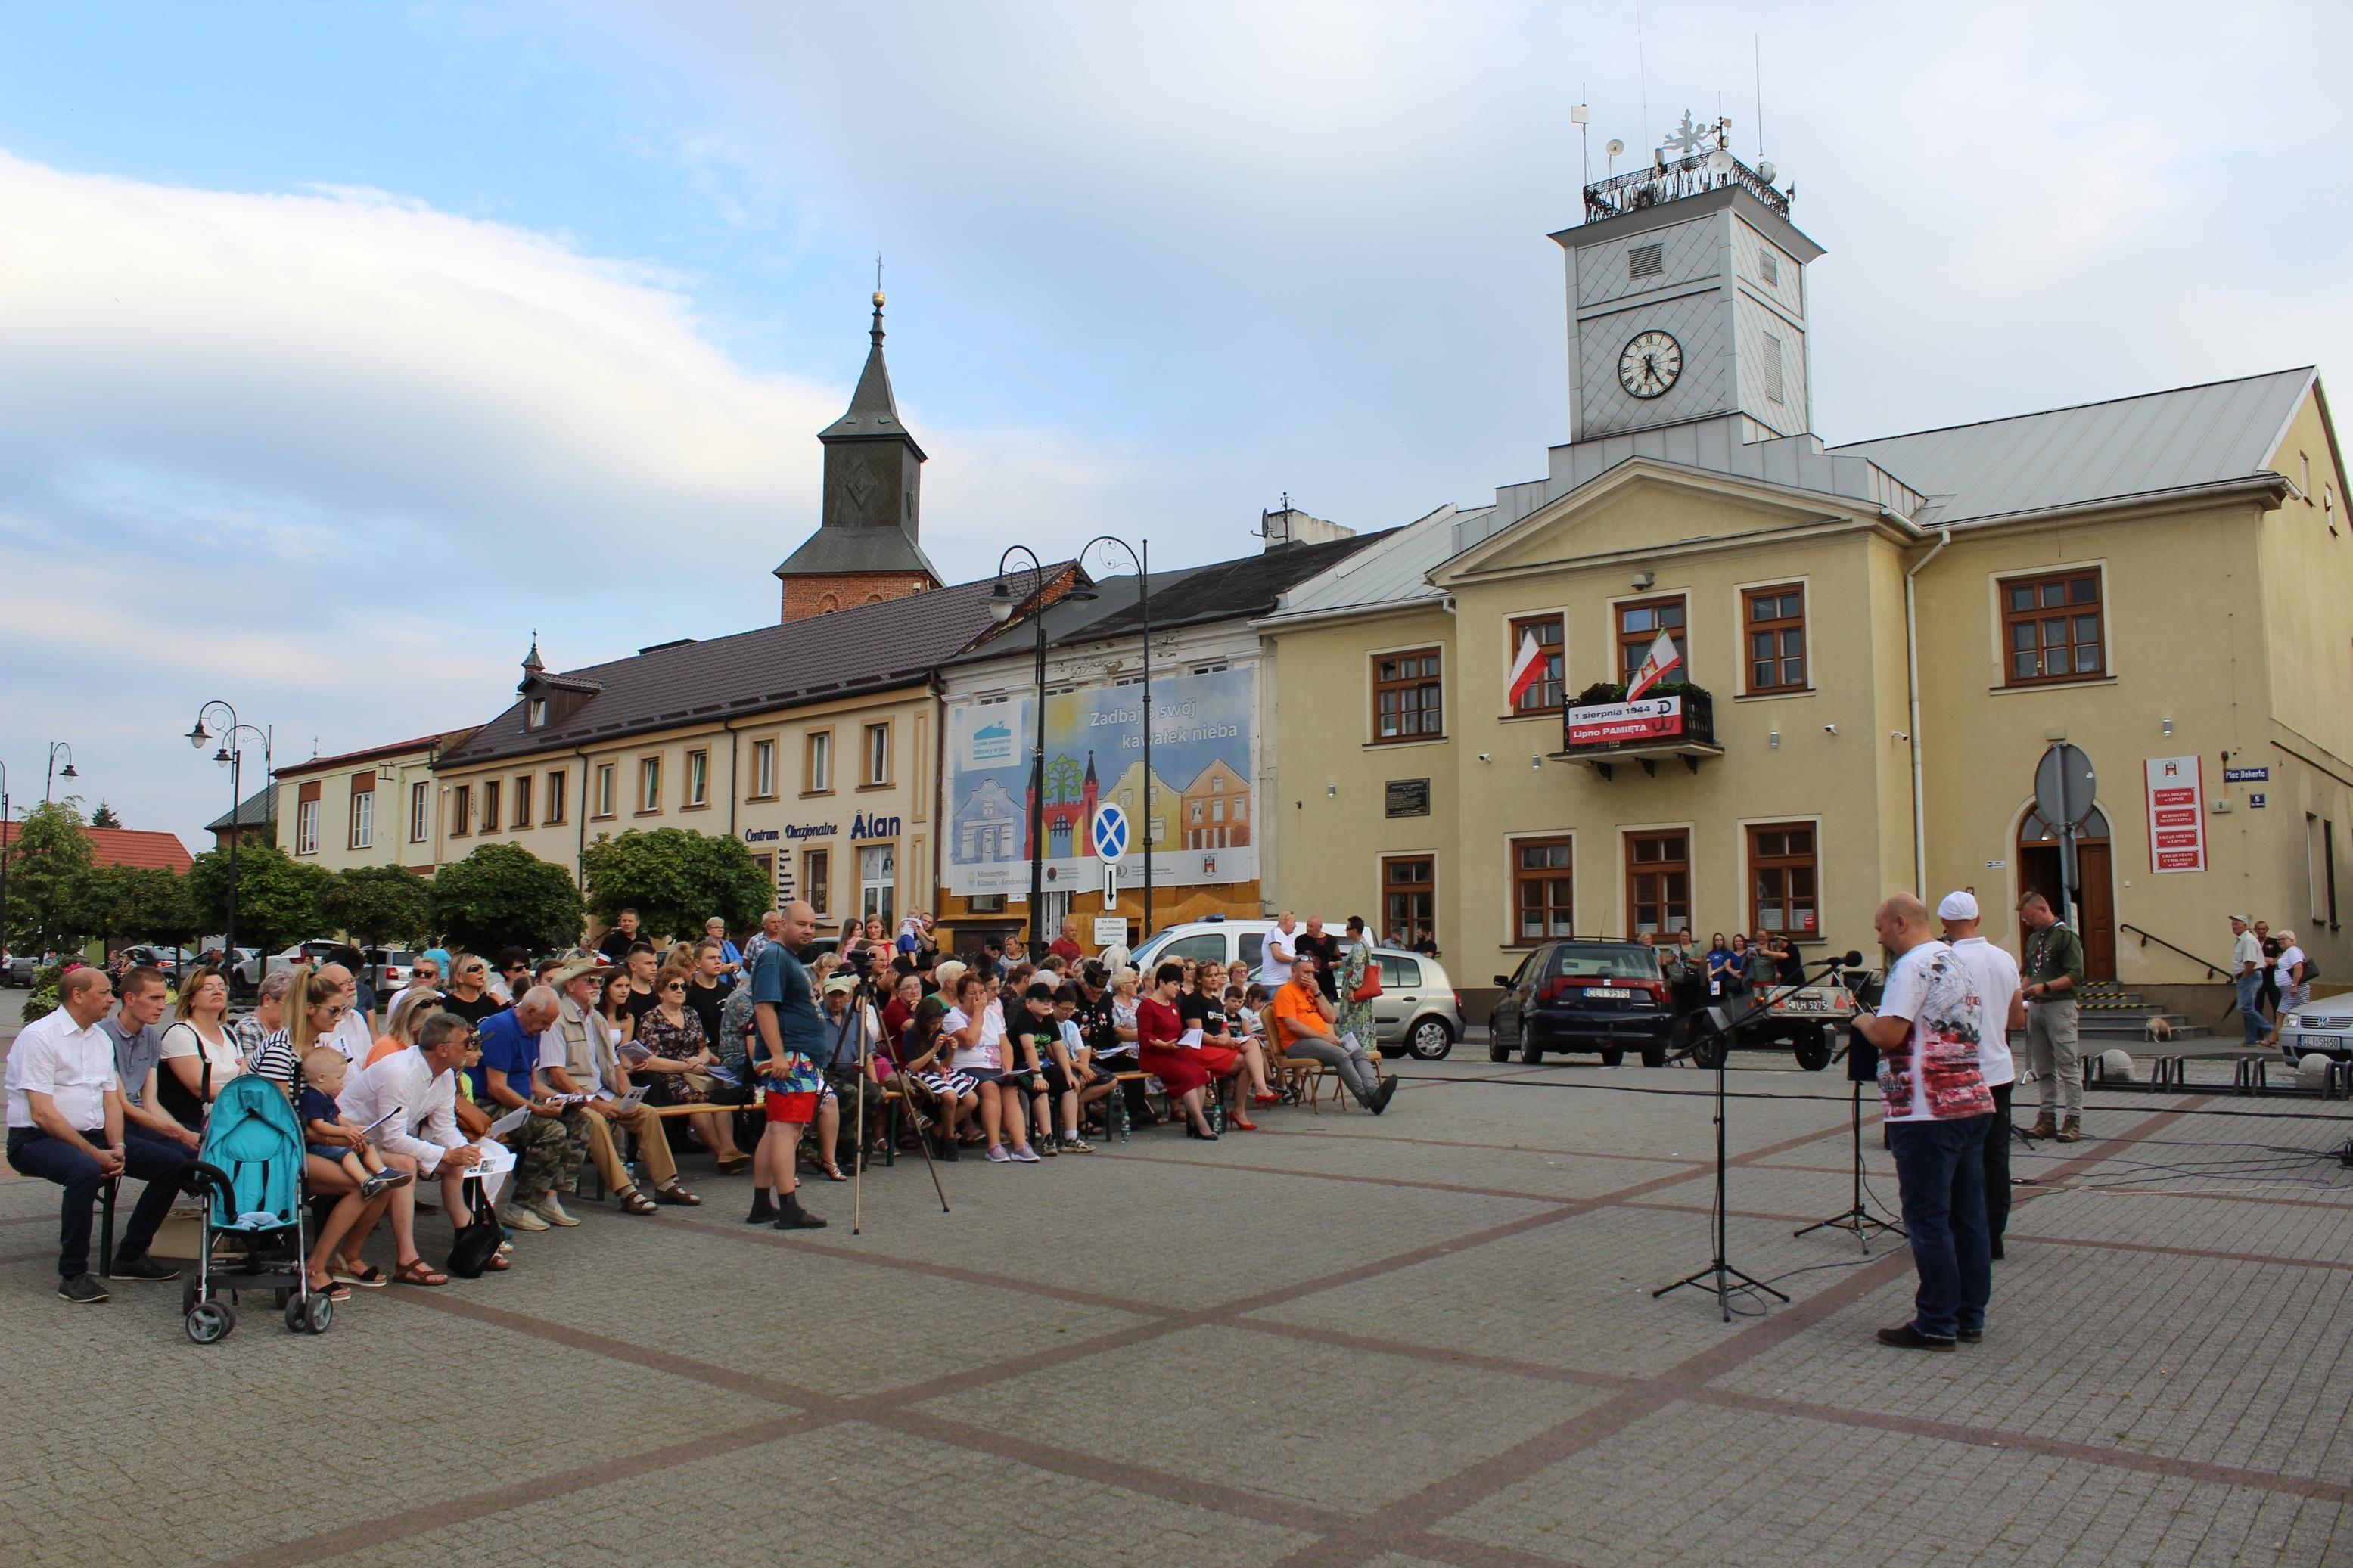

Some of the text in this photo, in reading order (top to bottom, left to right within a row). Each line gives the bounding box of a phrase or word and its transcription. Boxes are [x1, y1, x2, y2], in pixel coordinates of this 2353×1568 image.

[1090, 706, 1141, 727] Zadbaj
[1160, 697, 1196, 718] swój
[1582, 709, 1623, 719] sierpnia
[1625, 706, 1651, 715] 1944
[1122, 723, 1238, 749] kawałek nieba
[1574, 724, 1647, 739] Lipno PAMIĘTA
[2226, 770, 2266, 779] Plac Dekerta
[745, 812, 900, 842] Centrum Okazjonalne Alan
[2302, 1036, 2339, 1048] CLI SH60
